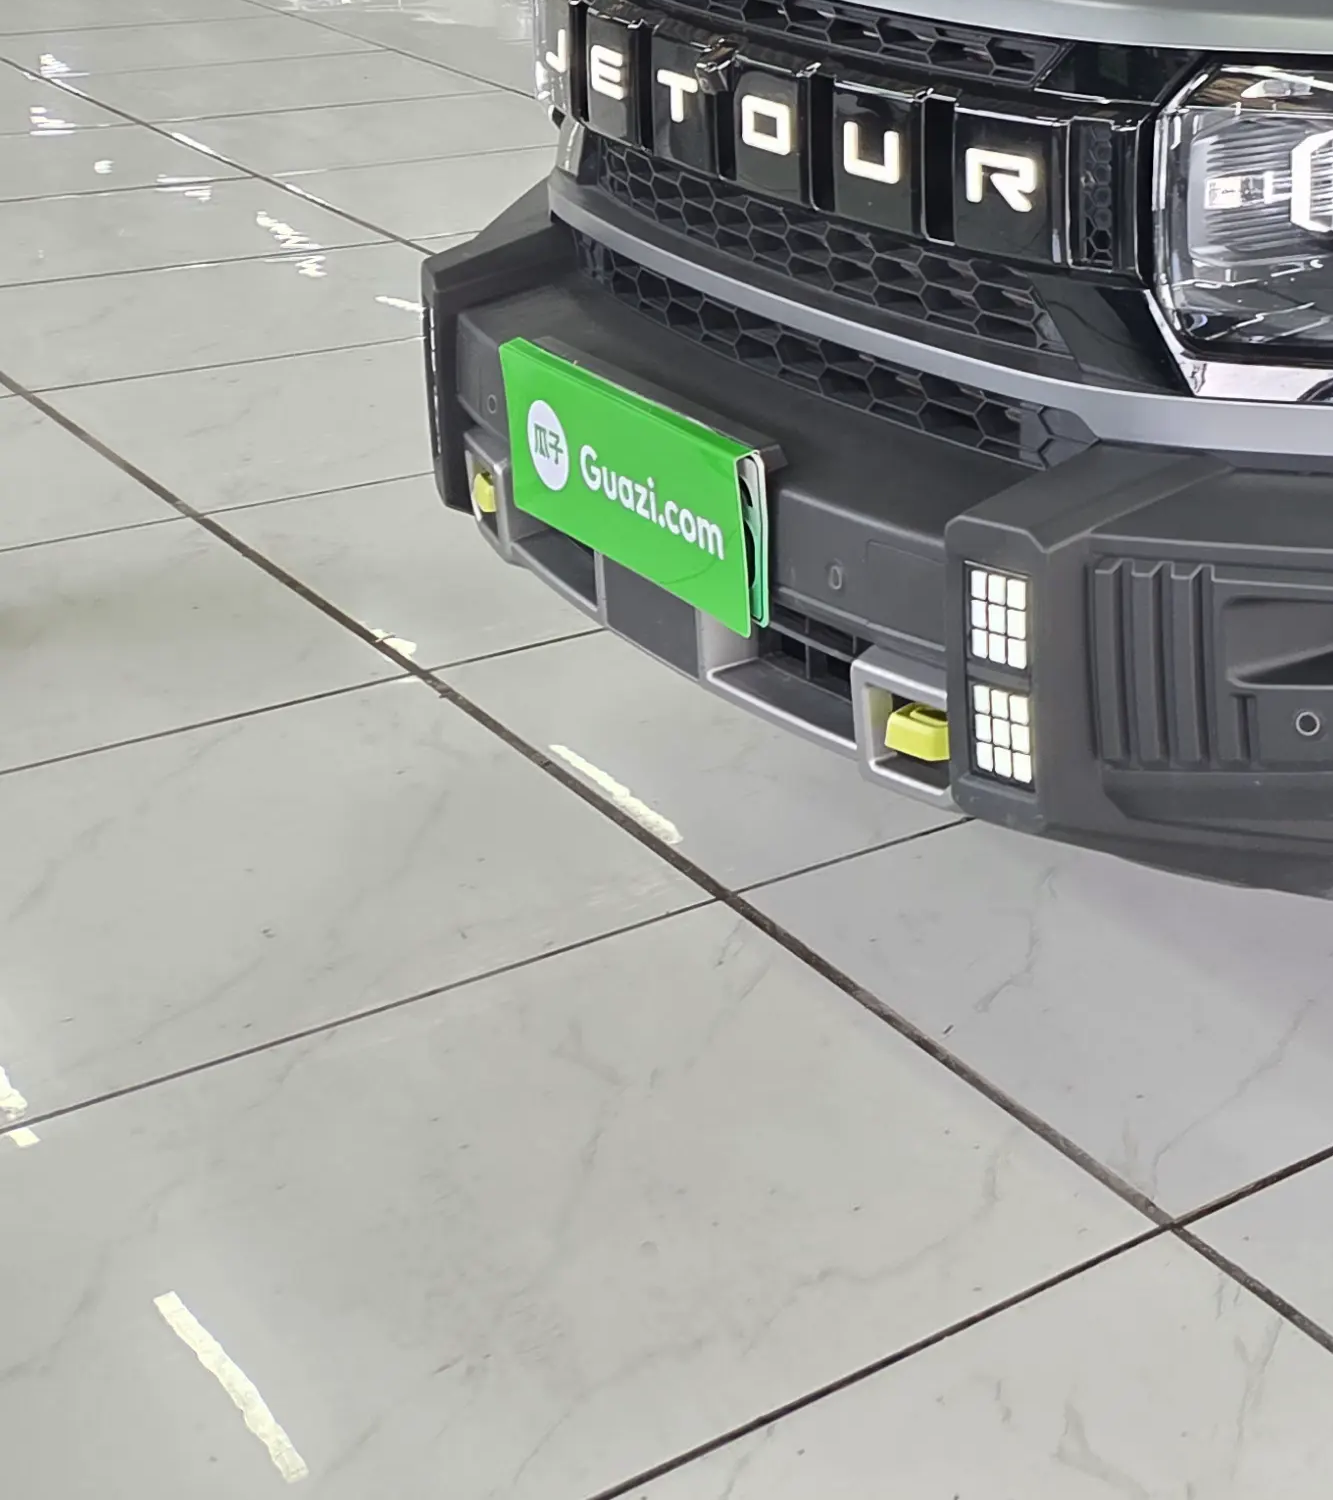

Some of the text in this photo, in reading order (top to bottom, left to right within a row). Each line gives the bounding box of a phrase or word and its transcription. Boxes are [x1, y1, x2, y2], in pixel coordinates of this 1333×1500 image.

[545, 28, 1037, 212] JETOUR
[533, 421, 564, 466] 瓜子
[579, 444, 725, 560] Guazi.com
